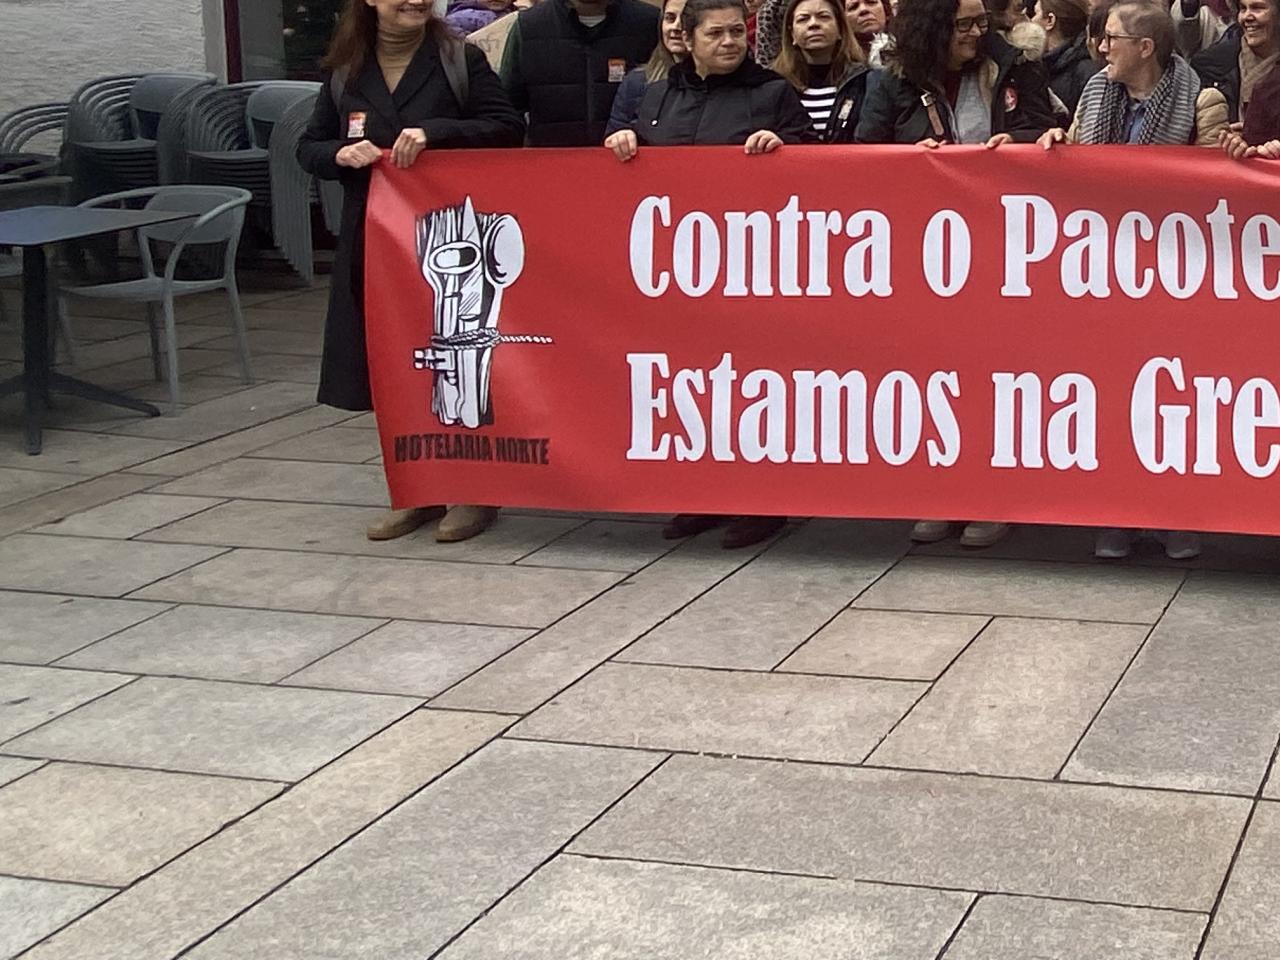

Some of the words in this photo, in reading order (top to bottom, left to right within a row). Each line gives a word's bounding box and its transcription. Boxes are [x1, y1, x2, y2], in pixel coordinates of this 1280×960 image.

[629, 195, 893, 298] Contra
[923, 209, 972, 297] o
[394, 433, 492, 463] HOTELARIA
[495, 437, 551, 465] NORTE
[626, 352, 961, 468] Estamos
[991, 371, 1099, 471] na
